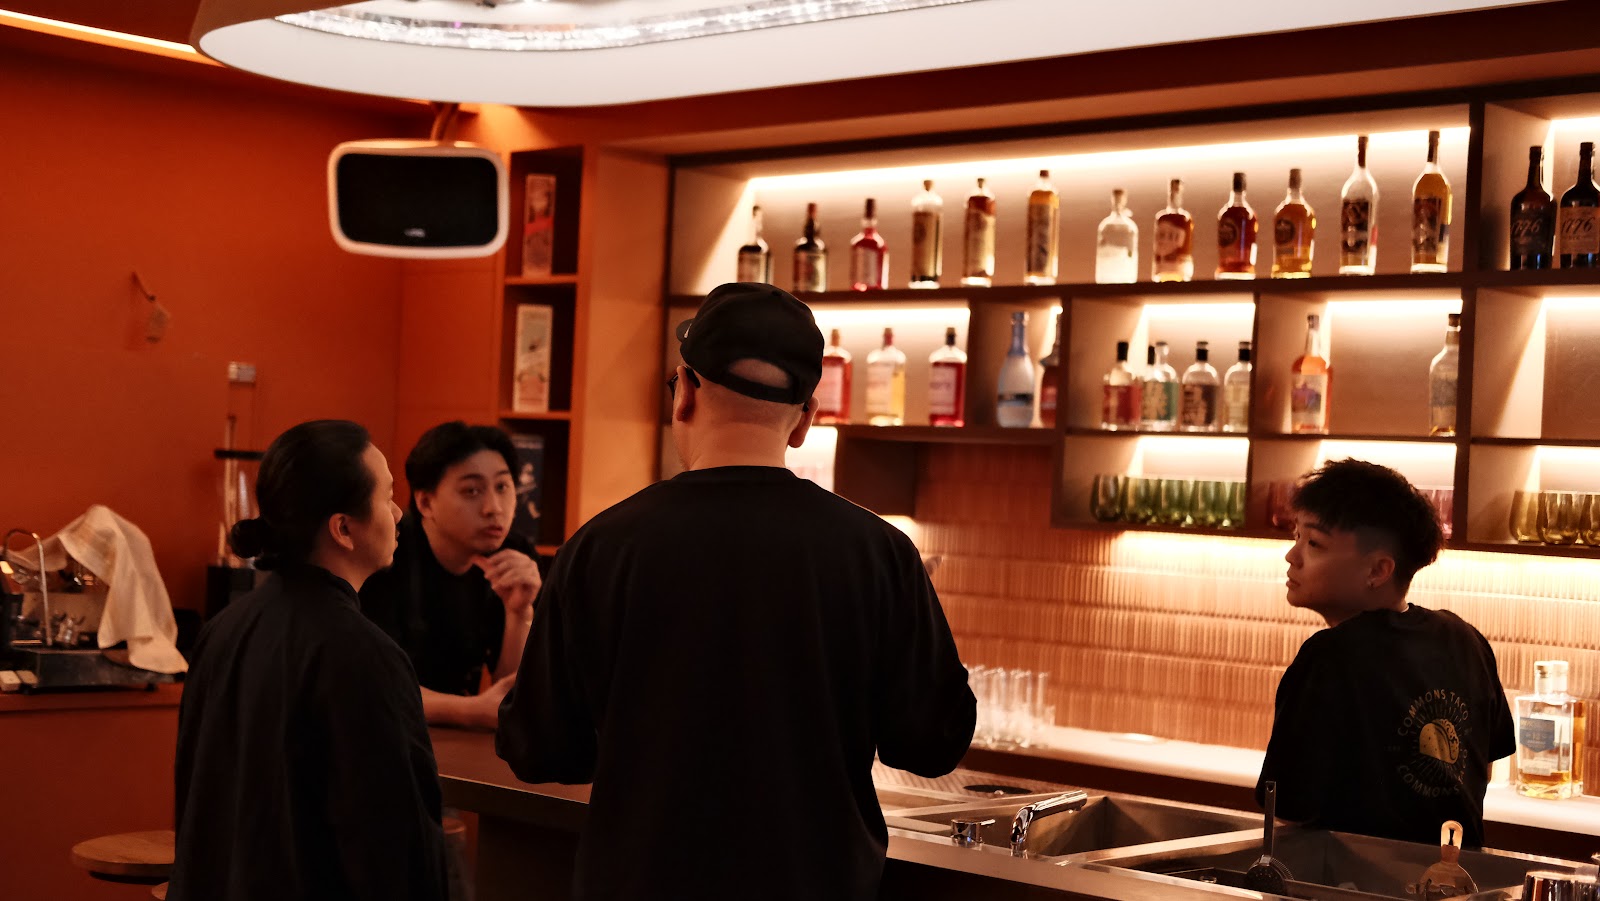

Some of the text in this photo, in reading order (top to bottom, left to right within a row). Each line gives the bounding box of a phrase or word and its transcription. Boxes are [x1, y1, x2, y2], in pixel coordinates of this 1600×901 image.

[1511, 218, 1543, 237] 1776
[1561, 216, 1595, 234] 1776
[1397, 689, 1468, 736] COMMONS TACO
[1397, 764, 1460, 797] COMMONS
